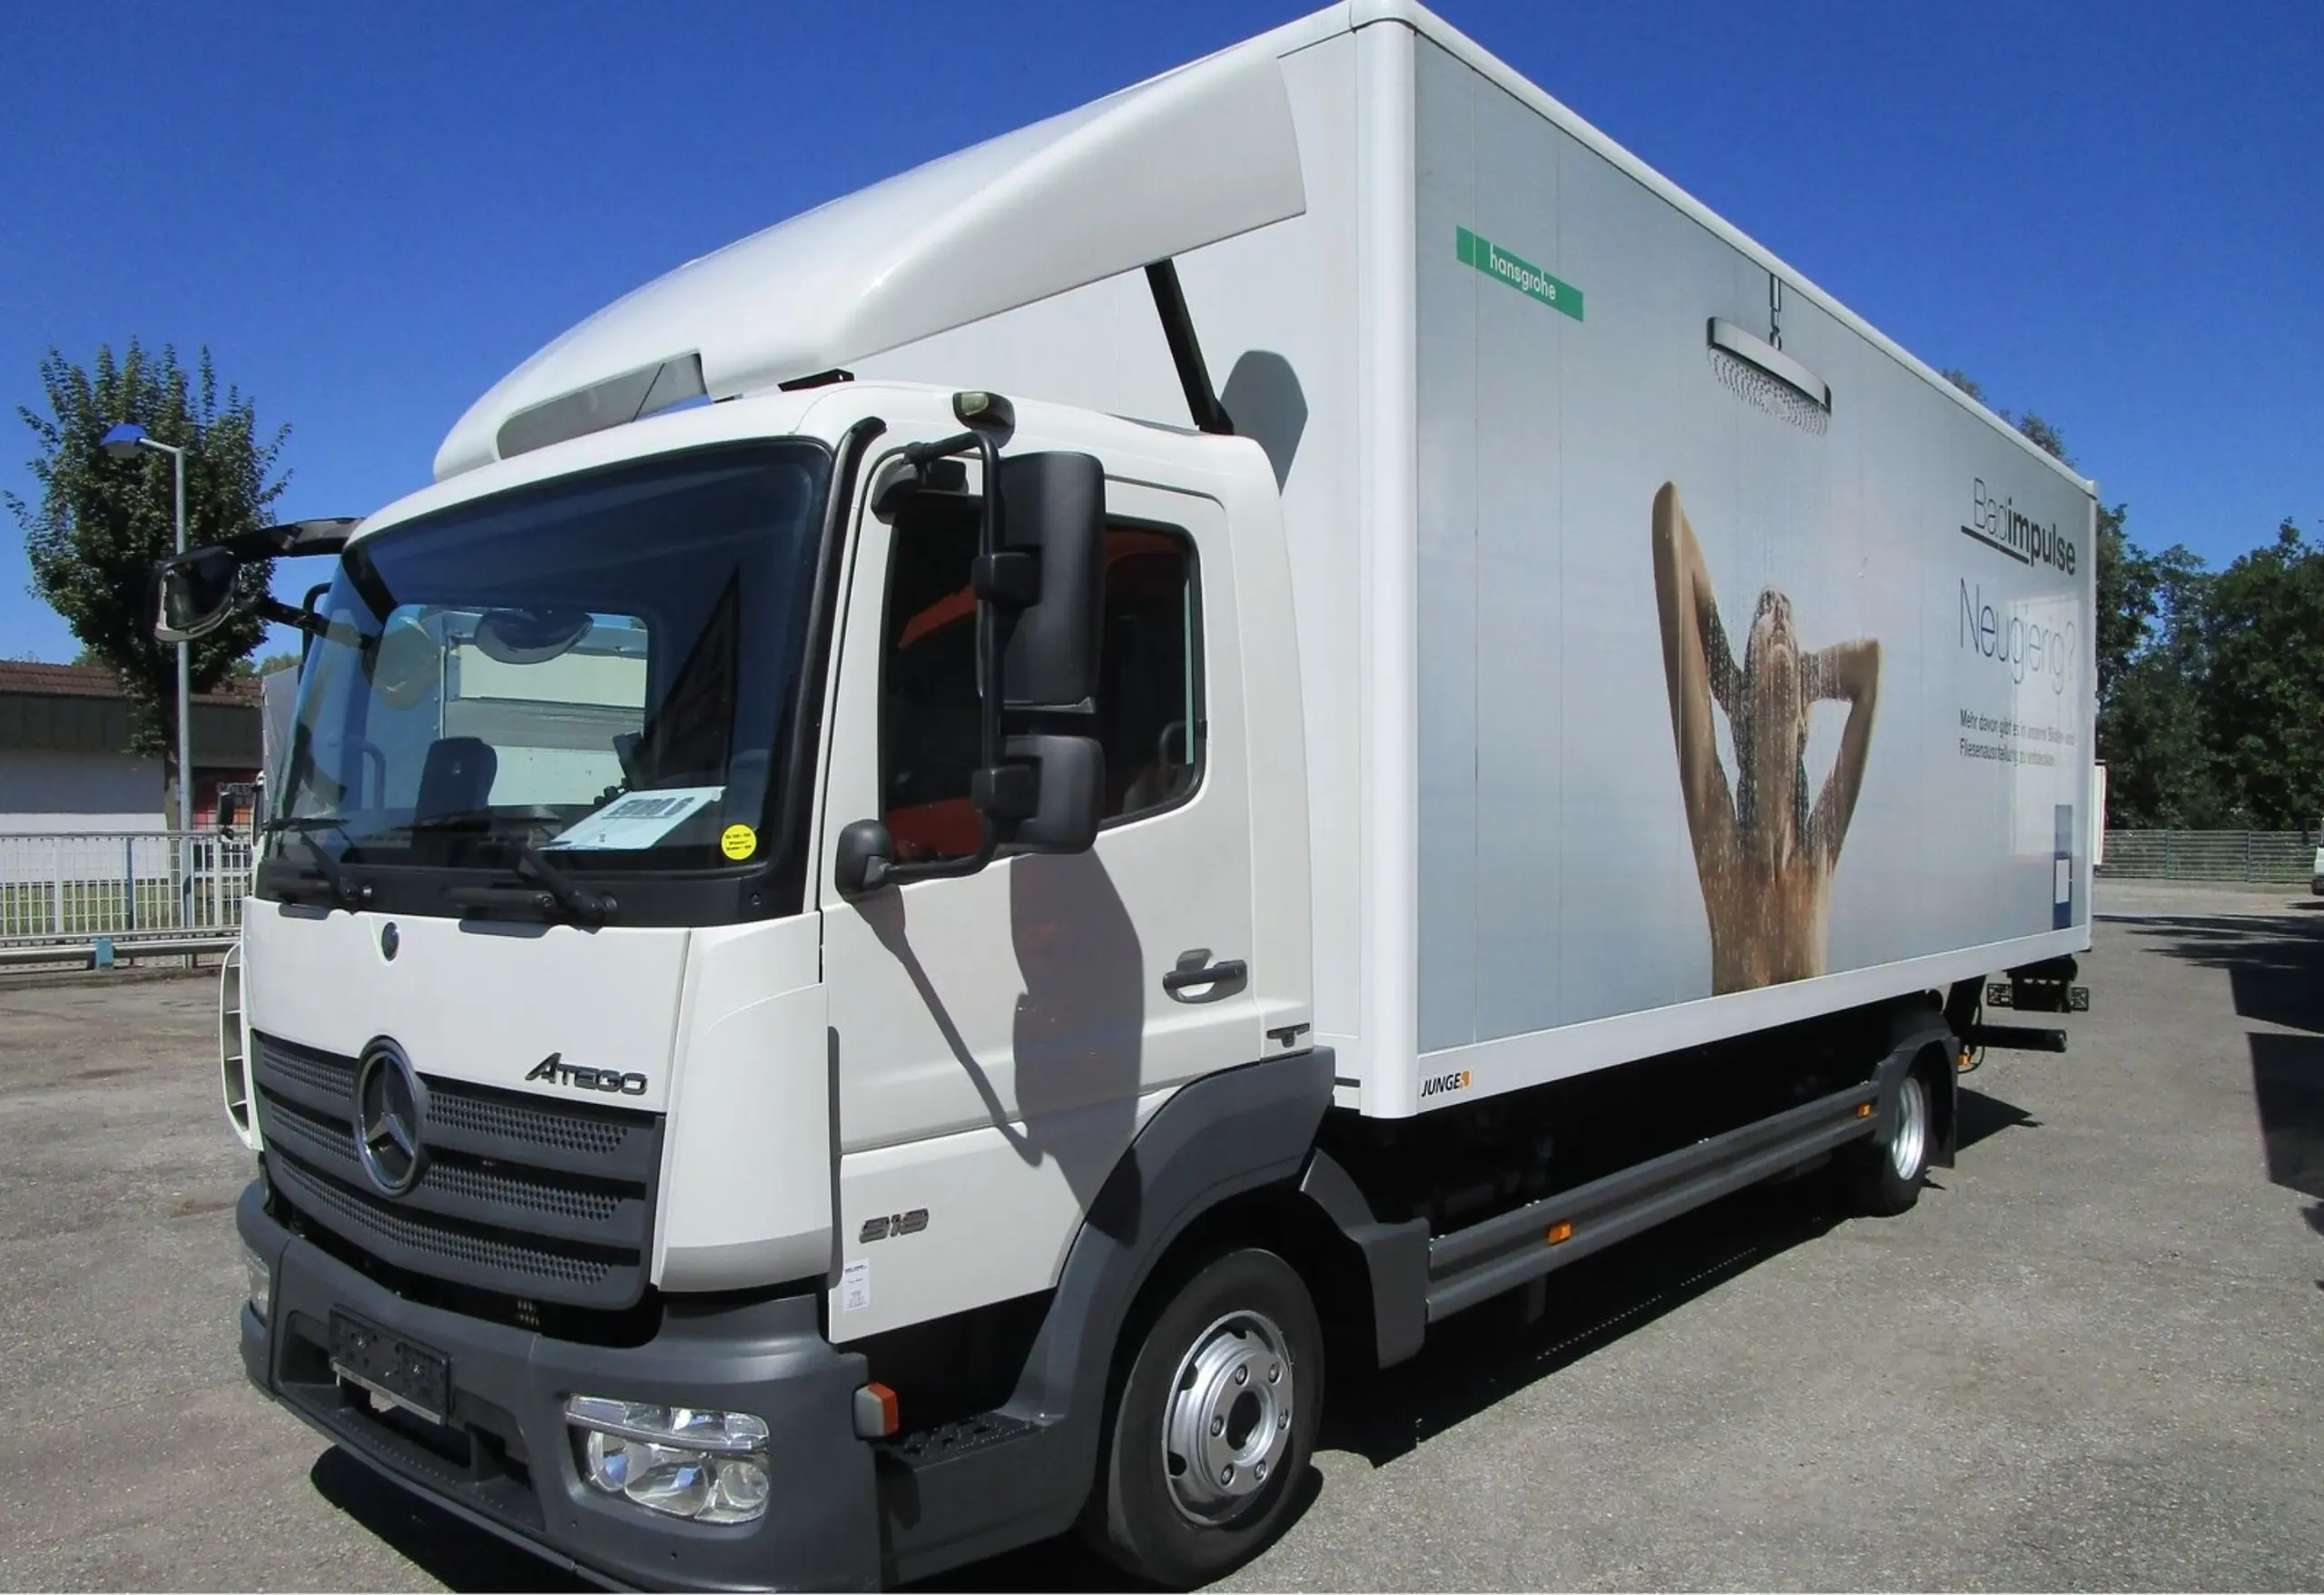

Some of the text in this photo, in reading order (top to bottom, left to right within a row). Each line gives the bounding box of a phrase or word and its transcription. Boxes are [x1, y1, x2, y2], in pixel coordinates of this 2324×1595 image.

[1489, 242, 1557, 300] hansgrohe
[1974, 477, 2076, 576] Badimpulse
[1959, 576, 2076, 696] Neugierig?
